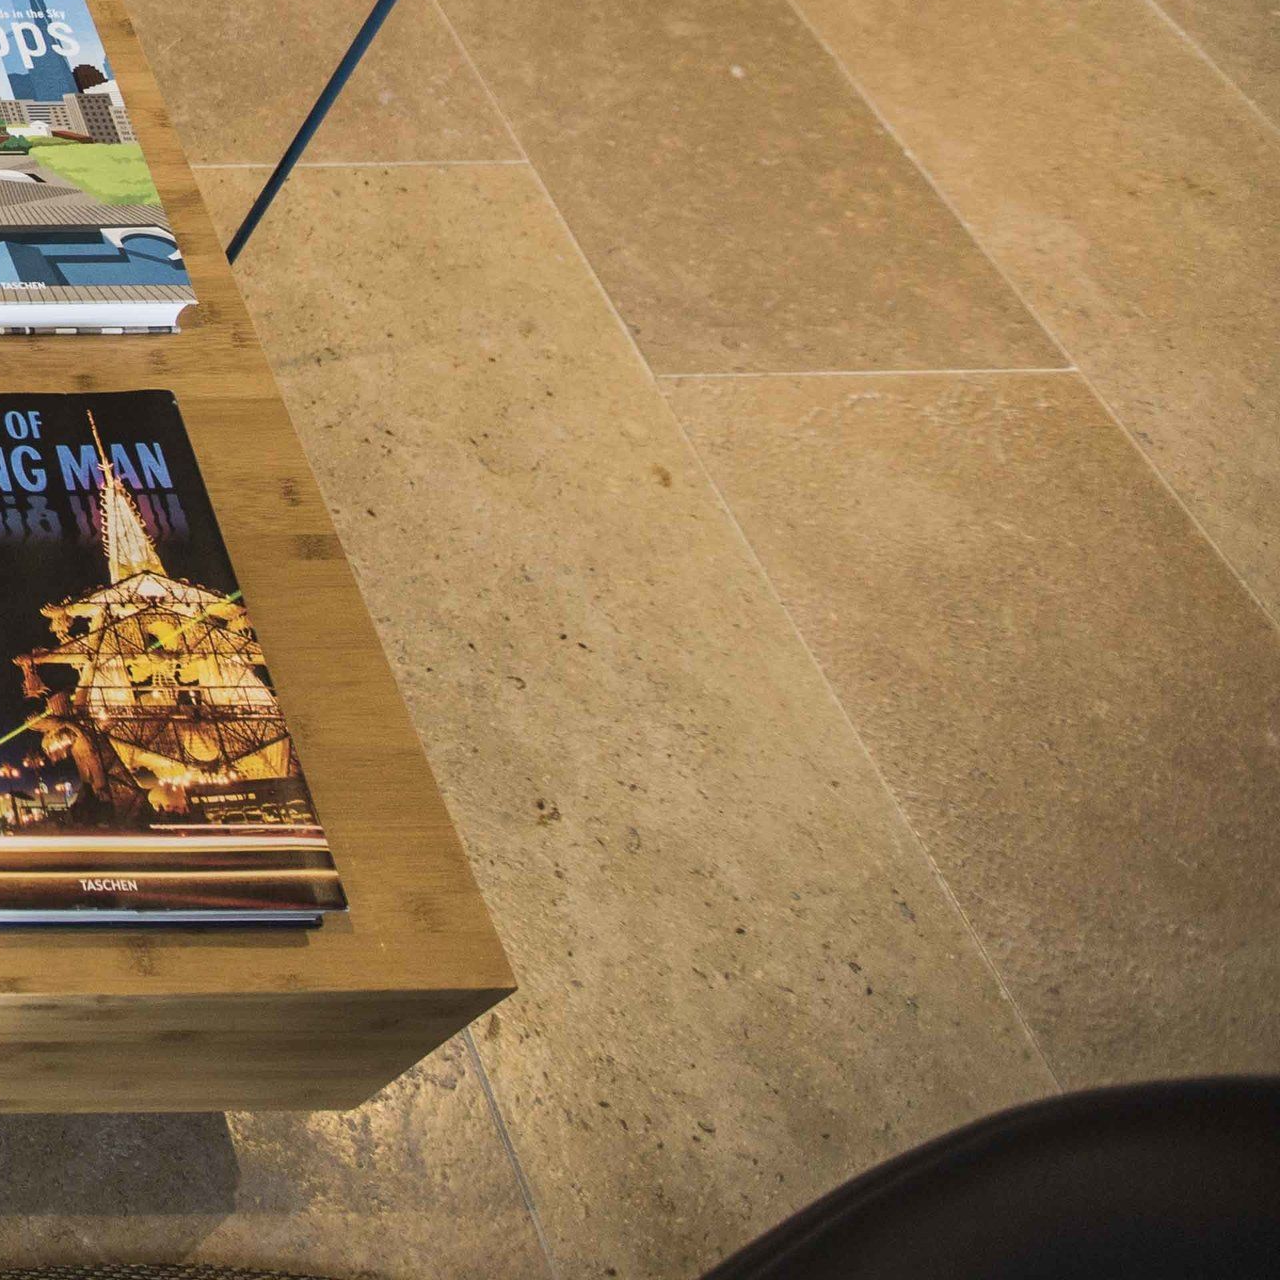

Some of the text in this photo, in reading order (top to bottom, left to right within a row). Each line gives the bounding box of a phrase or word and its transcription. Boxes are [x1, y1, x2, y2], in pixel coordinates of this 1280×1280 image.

[12, 9, 23, 18] in
[26, 9, 44, 18] the
[47, 9, 65, 20] Sky
[0, 281, 46, 290] TASCHEN
[3, 410, 43, 440] OF
[56, 442, 174, 492] MAN
[79, 879, 138, 892] TASCHEN
